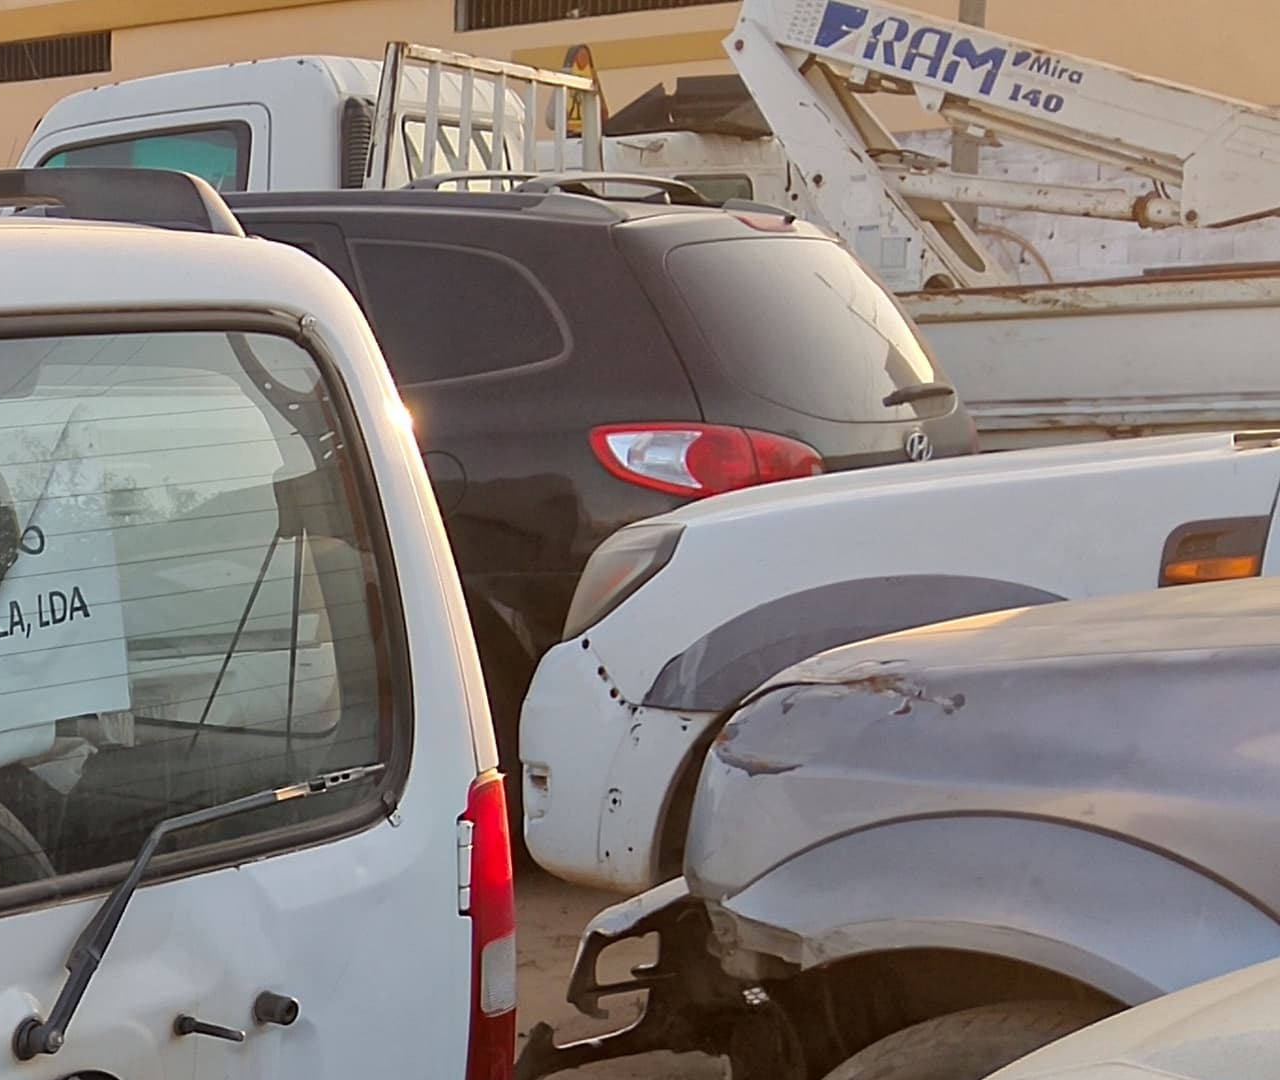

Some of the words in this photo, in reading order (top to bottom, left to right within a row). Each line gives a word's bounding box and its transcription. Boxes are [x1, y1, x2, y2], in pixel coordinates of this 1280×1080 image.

[1028, 56, 1084, 85] Mira
[1009, 83, 1065, 113] 140
[38, 586, 91, 628] LDA
